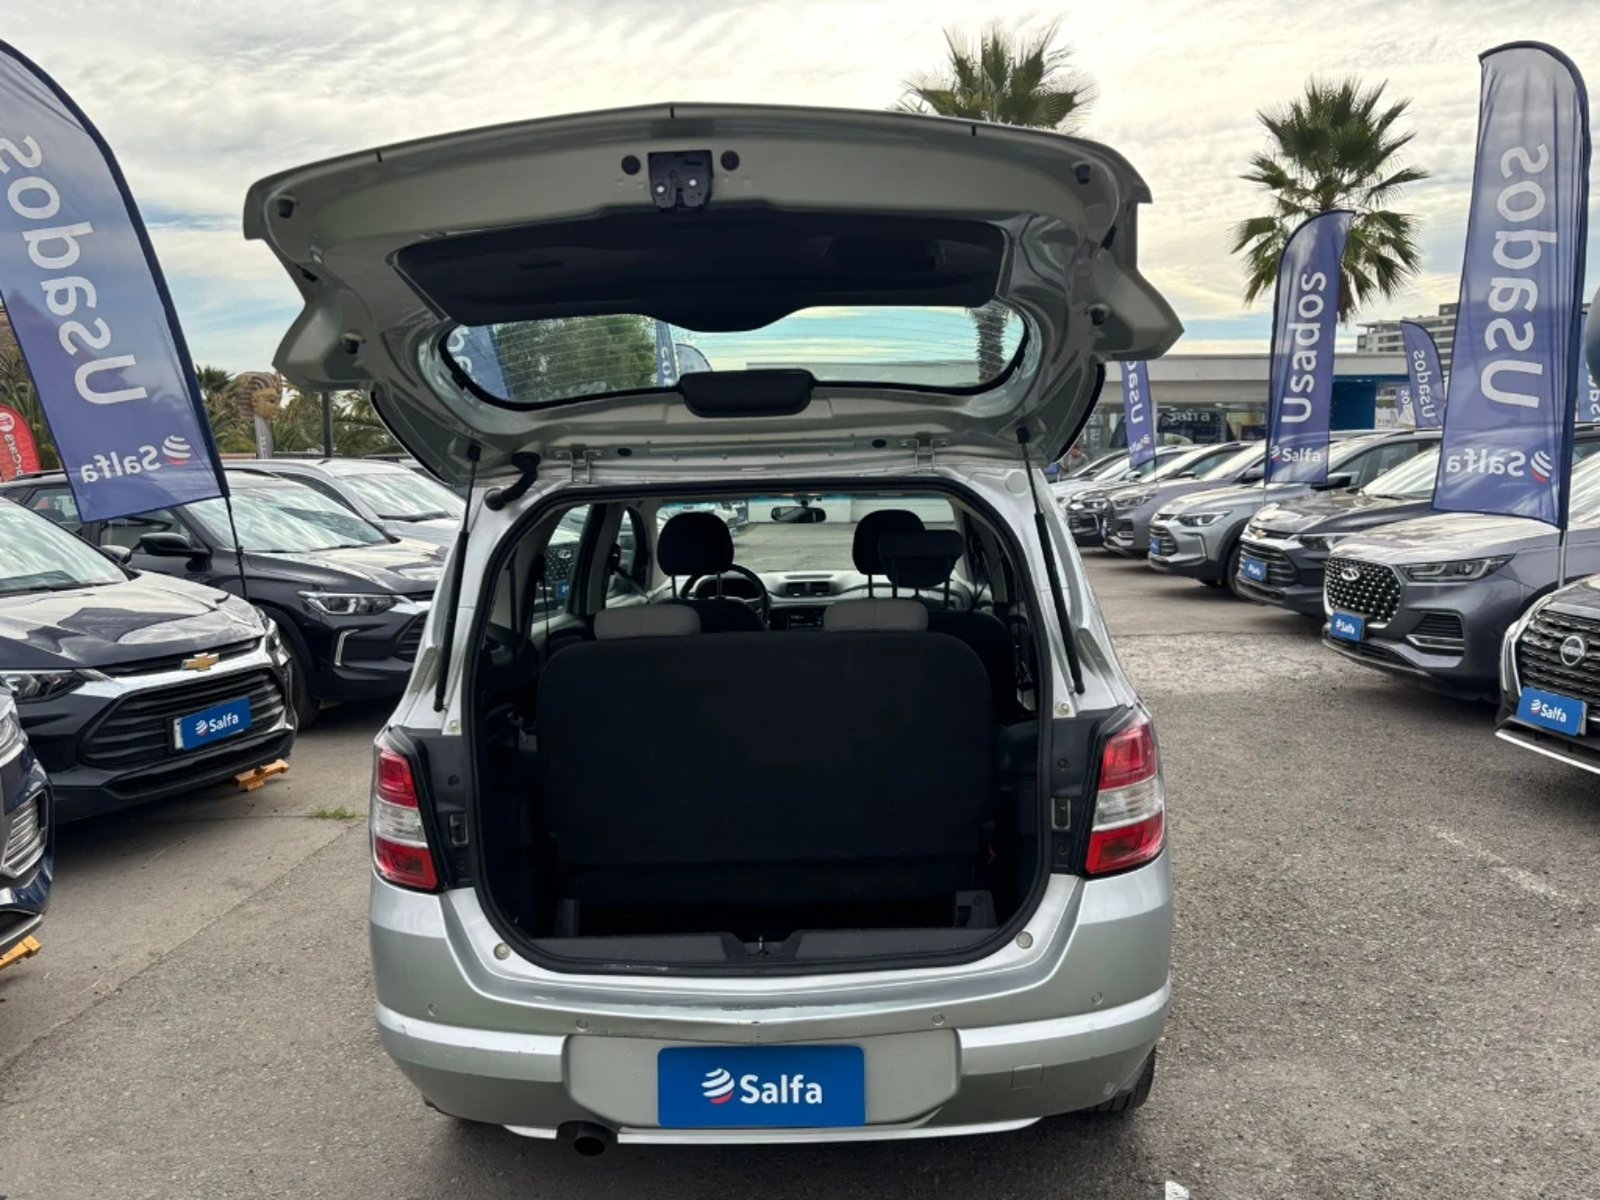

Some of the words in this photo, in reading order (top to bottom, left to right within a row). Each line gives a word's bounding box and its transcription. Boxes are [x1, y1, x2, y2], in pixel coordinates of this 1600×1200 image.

[1281, 271, 1327, 423] Usados
[1282, 448, 1321, 462] Salfa
[209, 712, 239, 732] Salfa
[1540, 704, 1567, 723] Salfa
[740, 1074, 823, 1104] Salfa
